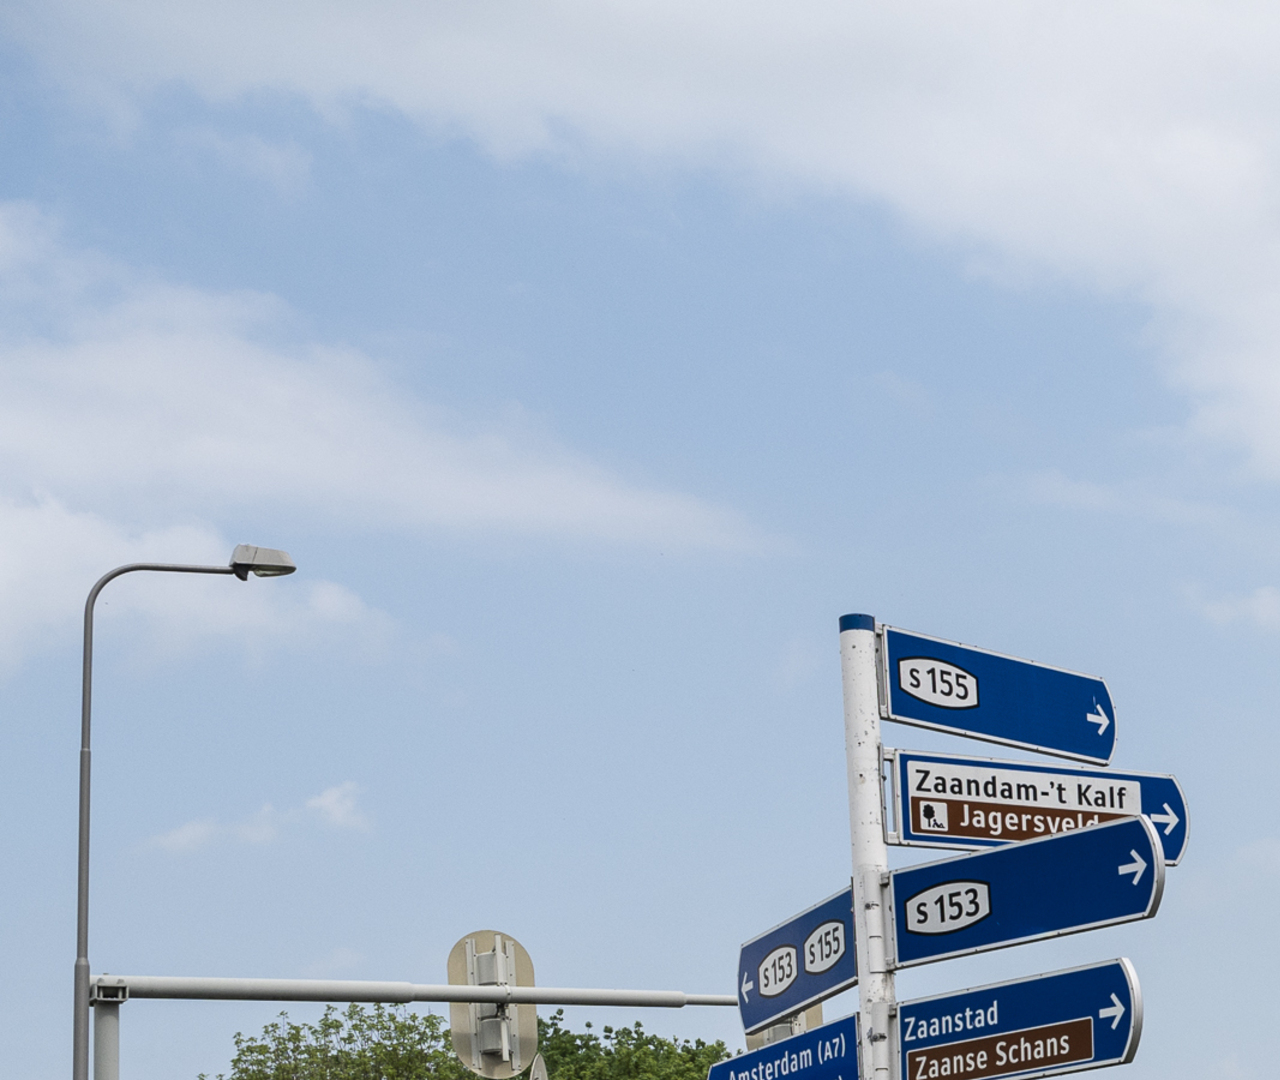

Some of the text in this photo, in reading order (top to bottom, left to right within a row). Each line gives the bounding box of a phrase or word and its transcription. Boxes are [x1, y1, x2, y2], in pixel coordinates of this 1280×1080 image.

[909, 666, 969, 701] S 155
[915, 768, 1127, 809] Zaandam-'t Kalf
[916, 887, 980, 925] S 153
[809, 925, 840, 965] S 155
[762, 951, 793, 988] S 153
[904, 999, 999, 1042] Zaanstad
[817, 1032, 846, 1065] (A7)
[915, 1034, 1070, 1080] Zaanse Schans
